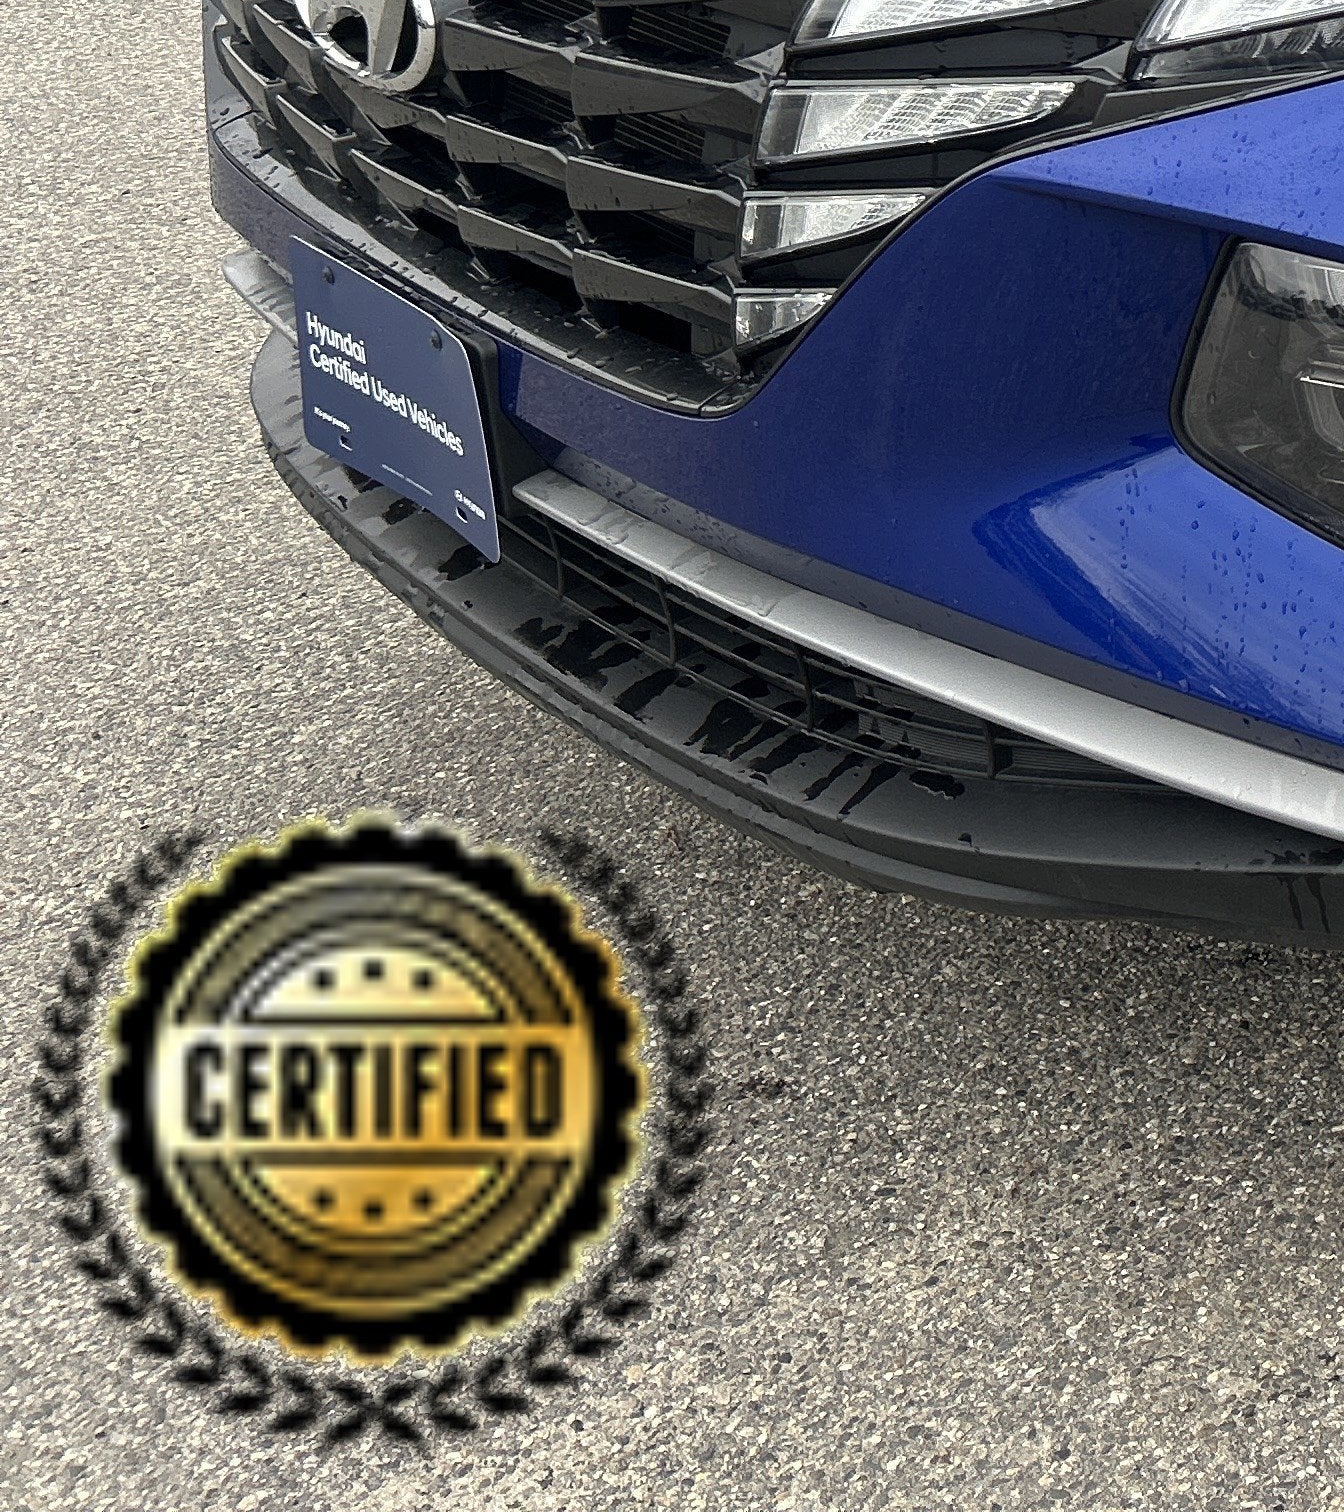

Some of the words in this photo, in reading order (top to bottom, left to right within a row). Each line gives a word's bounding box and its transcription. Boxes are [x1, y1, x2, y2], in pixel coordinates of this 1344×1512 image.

[306, 311, 367, 365] Hyundai
[309, 343, 370, 396] Certified
[370, 376, 408, 418] Used
[407, 397, 464, 457] Vehicles
